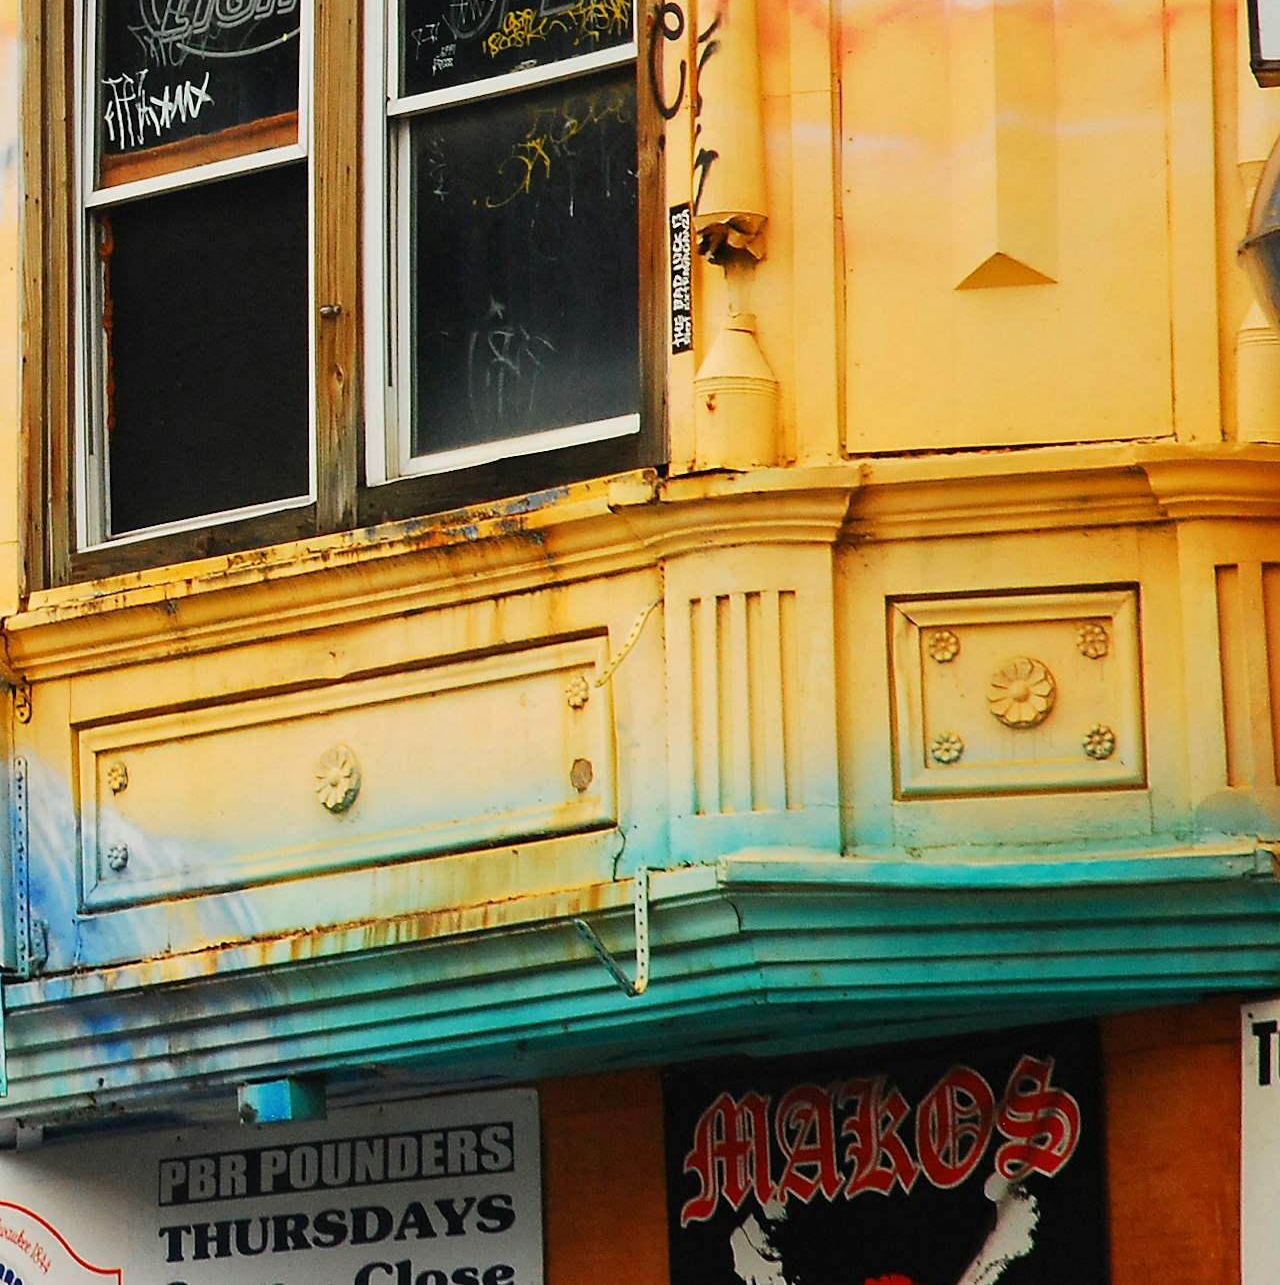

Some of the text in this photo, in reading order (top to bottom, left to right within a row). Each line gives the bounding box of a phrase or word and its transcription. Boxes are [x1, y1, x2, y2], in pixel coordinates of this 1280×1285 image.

[672, 233, 683, 271] LUCK
[672, 275, 684, 311] BAD
[672, 315, 685, 347] THE
[680, 1054, 1081, 1228] MAKOS
[160, 1125, 513, 1205] PBR POUNDERS
[158, 1194, 516, 1263] THURSDAYS
[30, 1242, 52, 1275] 1844
[354, 1259, 516, 1285] Close
